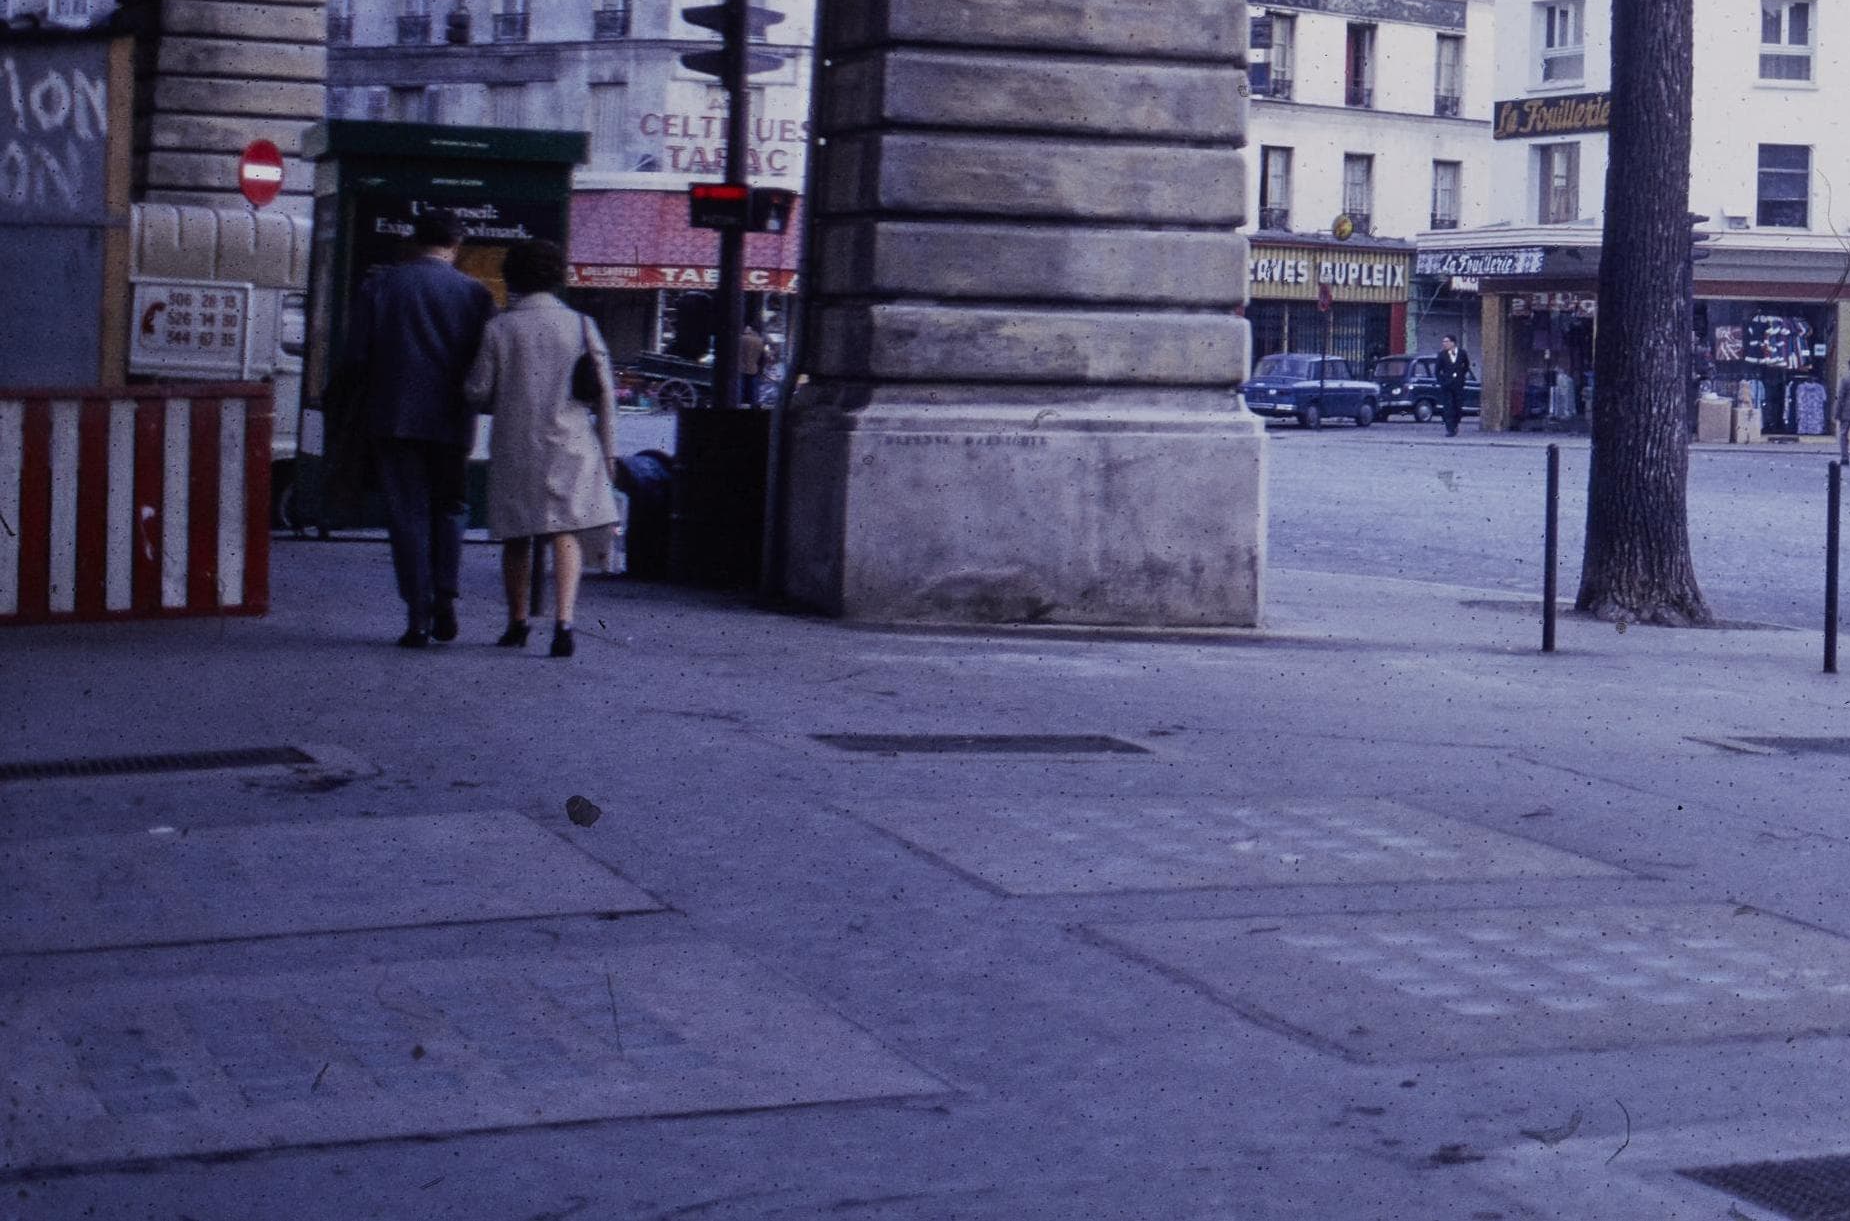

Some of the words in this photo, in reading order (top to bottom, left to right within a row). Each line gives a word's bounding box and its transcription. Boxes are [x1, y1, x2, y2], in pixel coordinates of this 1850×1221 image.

[640, 113, 809, 143] CELTIUES
[1520, 95, 1610, 133] Fouillerie
[661, 267, 770, 284] TABC
[1320, 261, 1404, 287] DUPLEIX
